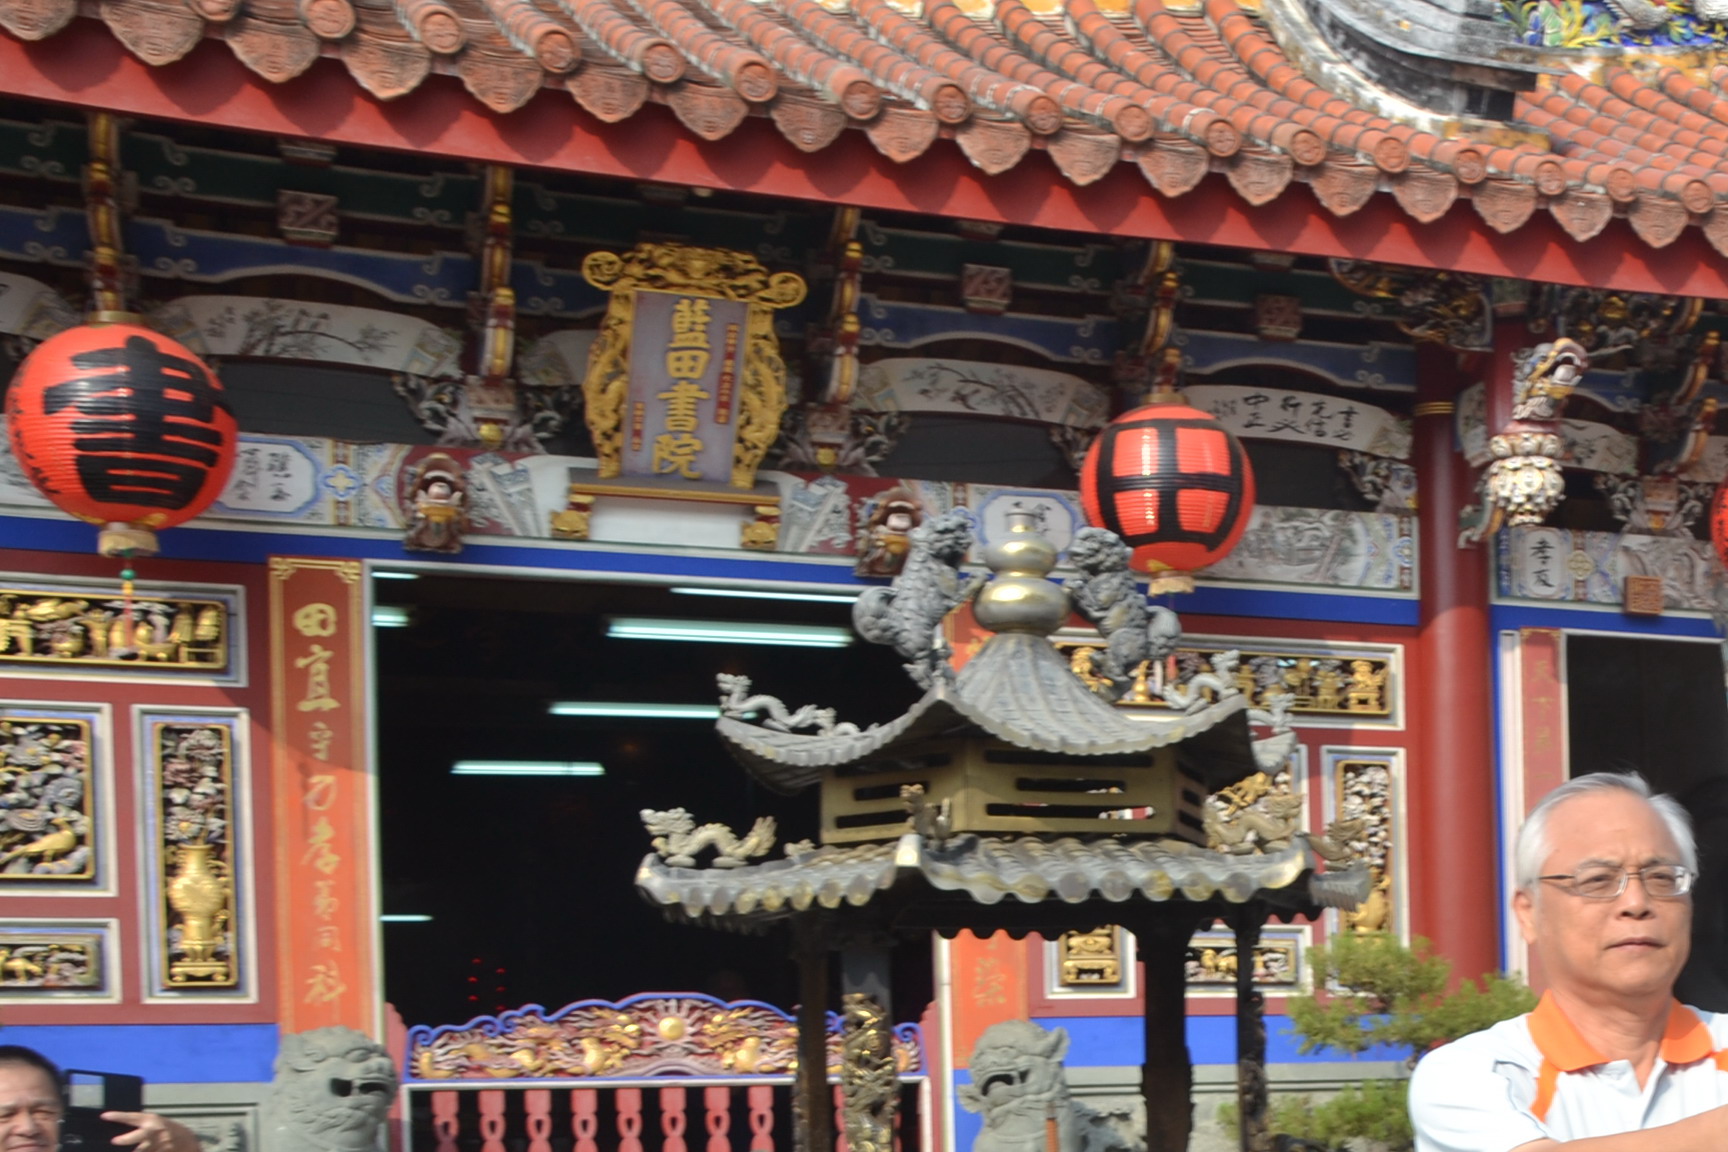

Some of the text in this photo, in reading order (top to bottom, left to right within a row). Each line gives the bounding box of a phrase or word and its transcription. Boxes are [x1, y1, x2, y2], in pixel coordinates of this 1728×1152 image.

[43, 335, 235, 511] 書
[652, 298, 712, 480] 藍田書院
[1103, 417, 1243, 553] 田
